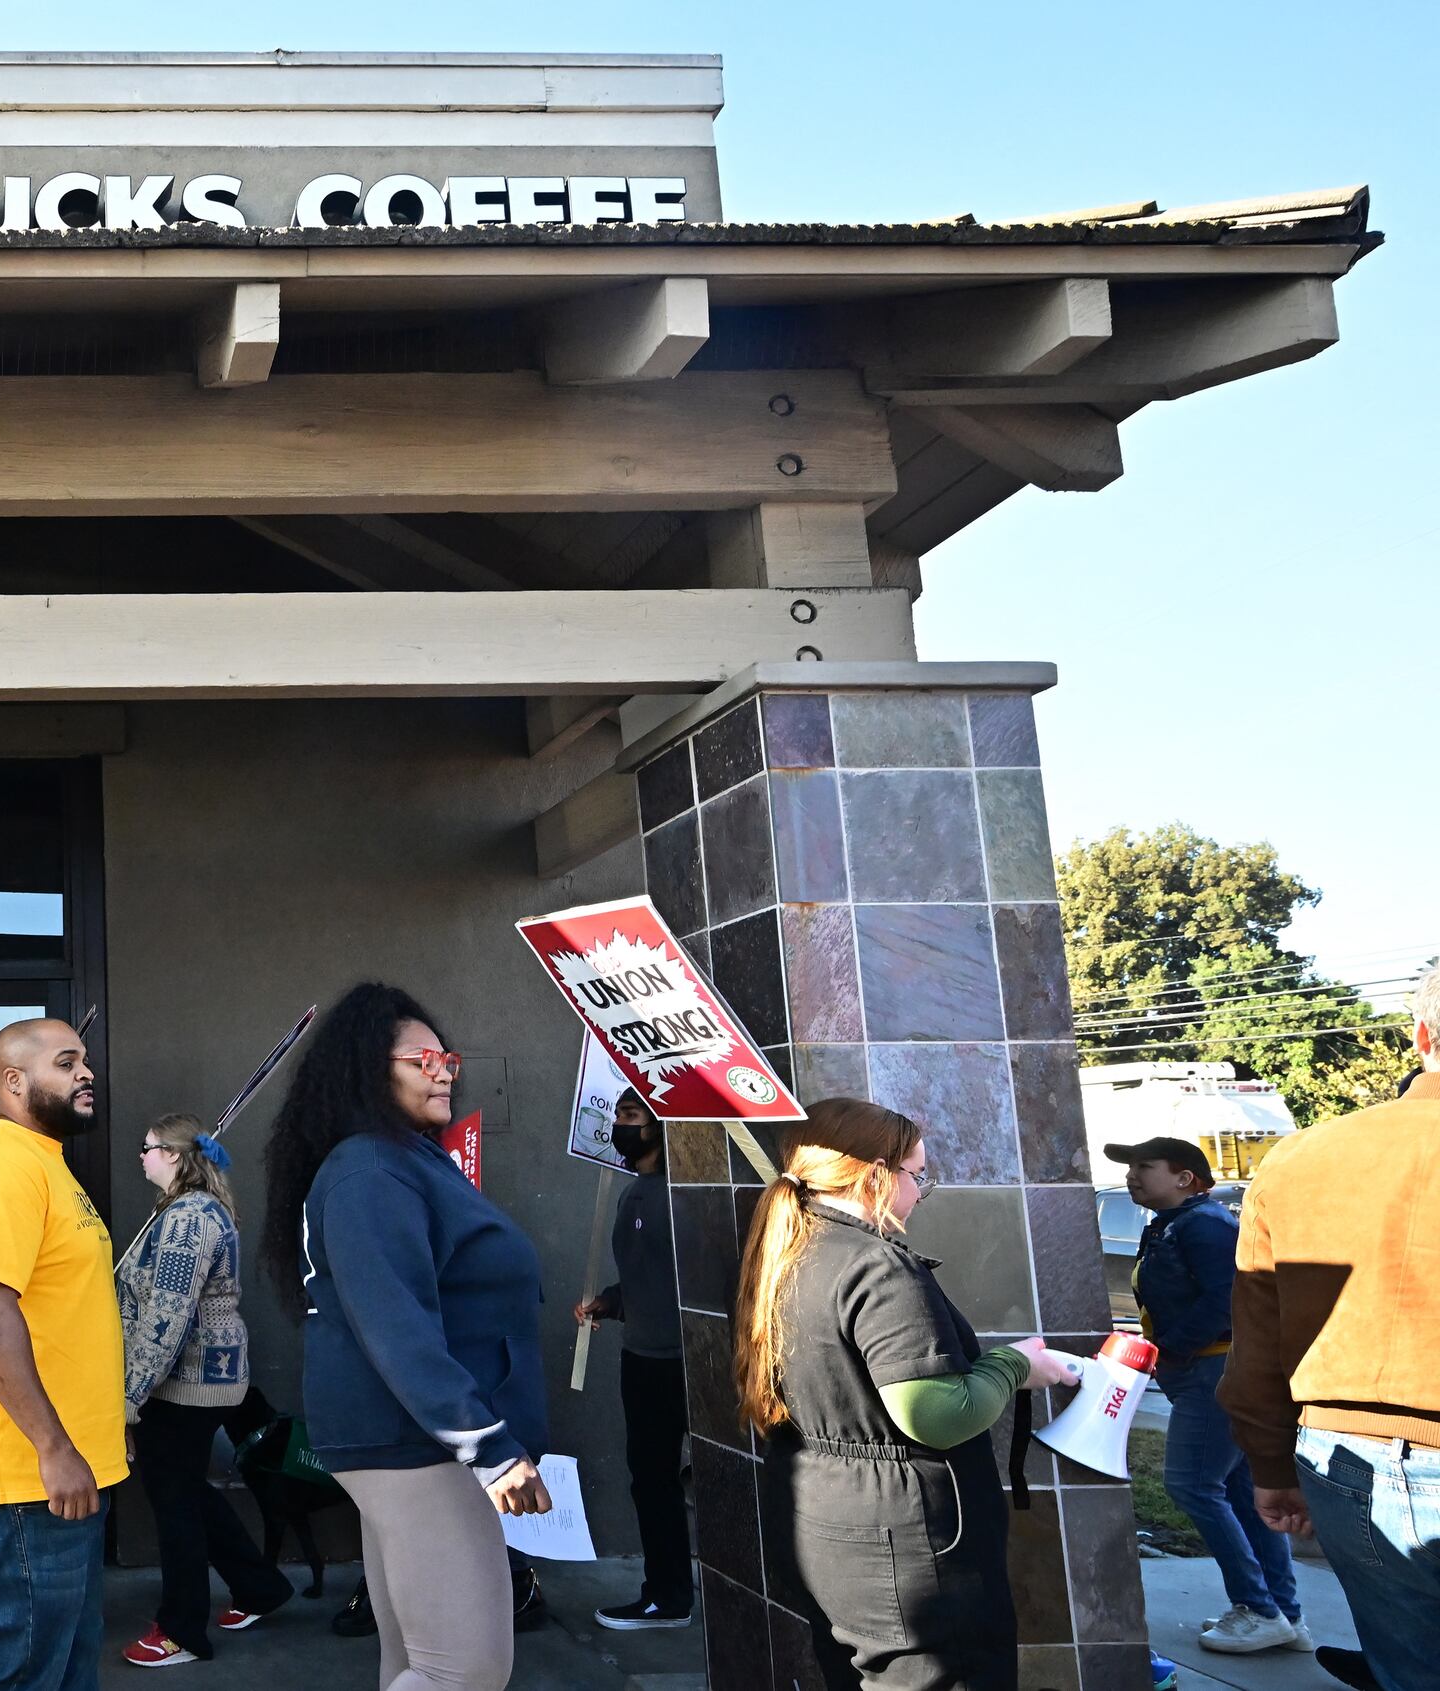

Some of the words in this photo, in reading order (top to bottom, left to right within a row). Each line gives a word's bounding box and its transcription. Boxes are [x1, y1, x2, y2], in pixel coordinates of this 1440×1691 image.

[295, 172, 687, 227] COFFEE
[577, 963, 675, 1009] UNION
[610, 1007, 725, 1056] STRONG!
